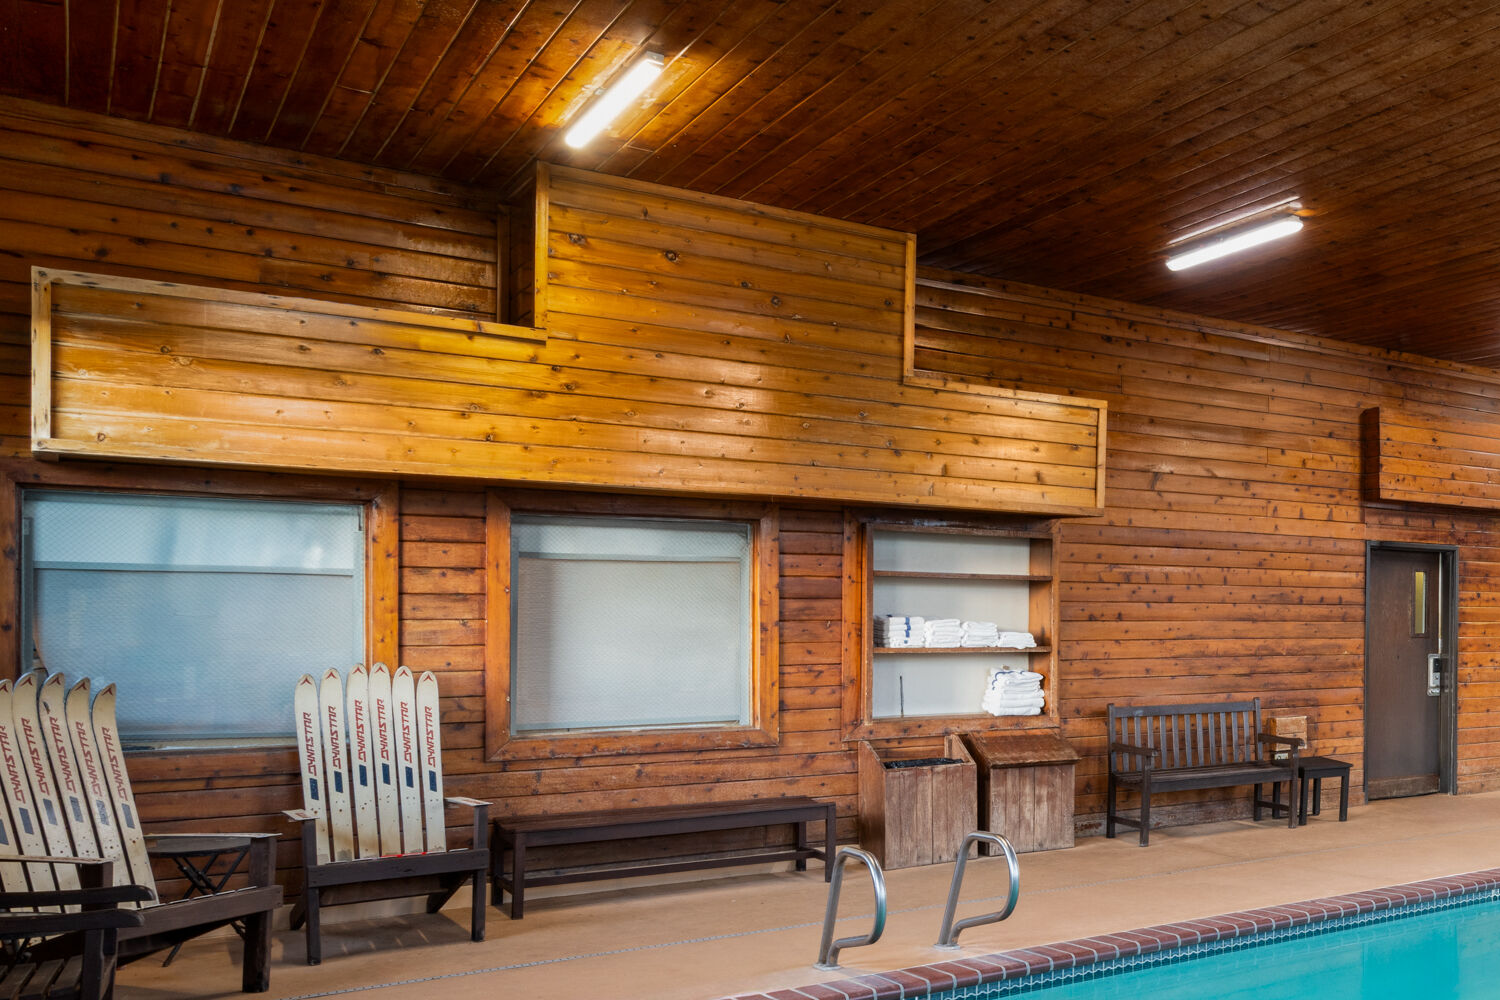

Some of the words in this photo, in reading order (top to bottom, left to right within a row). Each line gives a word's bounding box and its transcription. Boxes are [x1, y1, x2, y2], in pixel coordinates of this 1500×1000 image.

[20, 717, 50, 796] DYNASTAR
[50, 716, 77, 794] DYNASTAR
[75, 721, 103, 797] DYNASTAR
[303, 712, 317, 777] DYNASTAR
[328, 705, 342, 770] DYNASTAR
[354, 699, 367, 763] DYNASTAR
[377, 698, 389, 761] DYNASTAR
[400, 701, 413, 764] DYNASTAR
[424, 705, 436, 768] DYNASTAR
[101, 726, 128, 801] DYNASTAR
